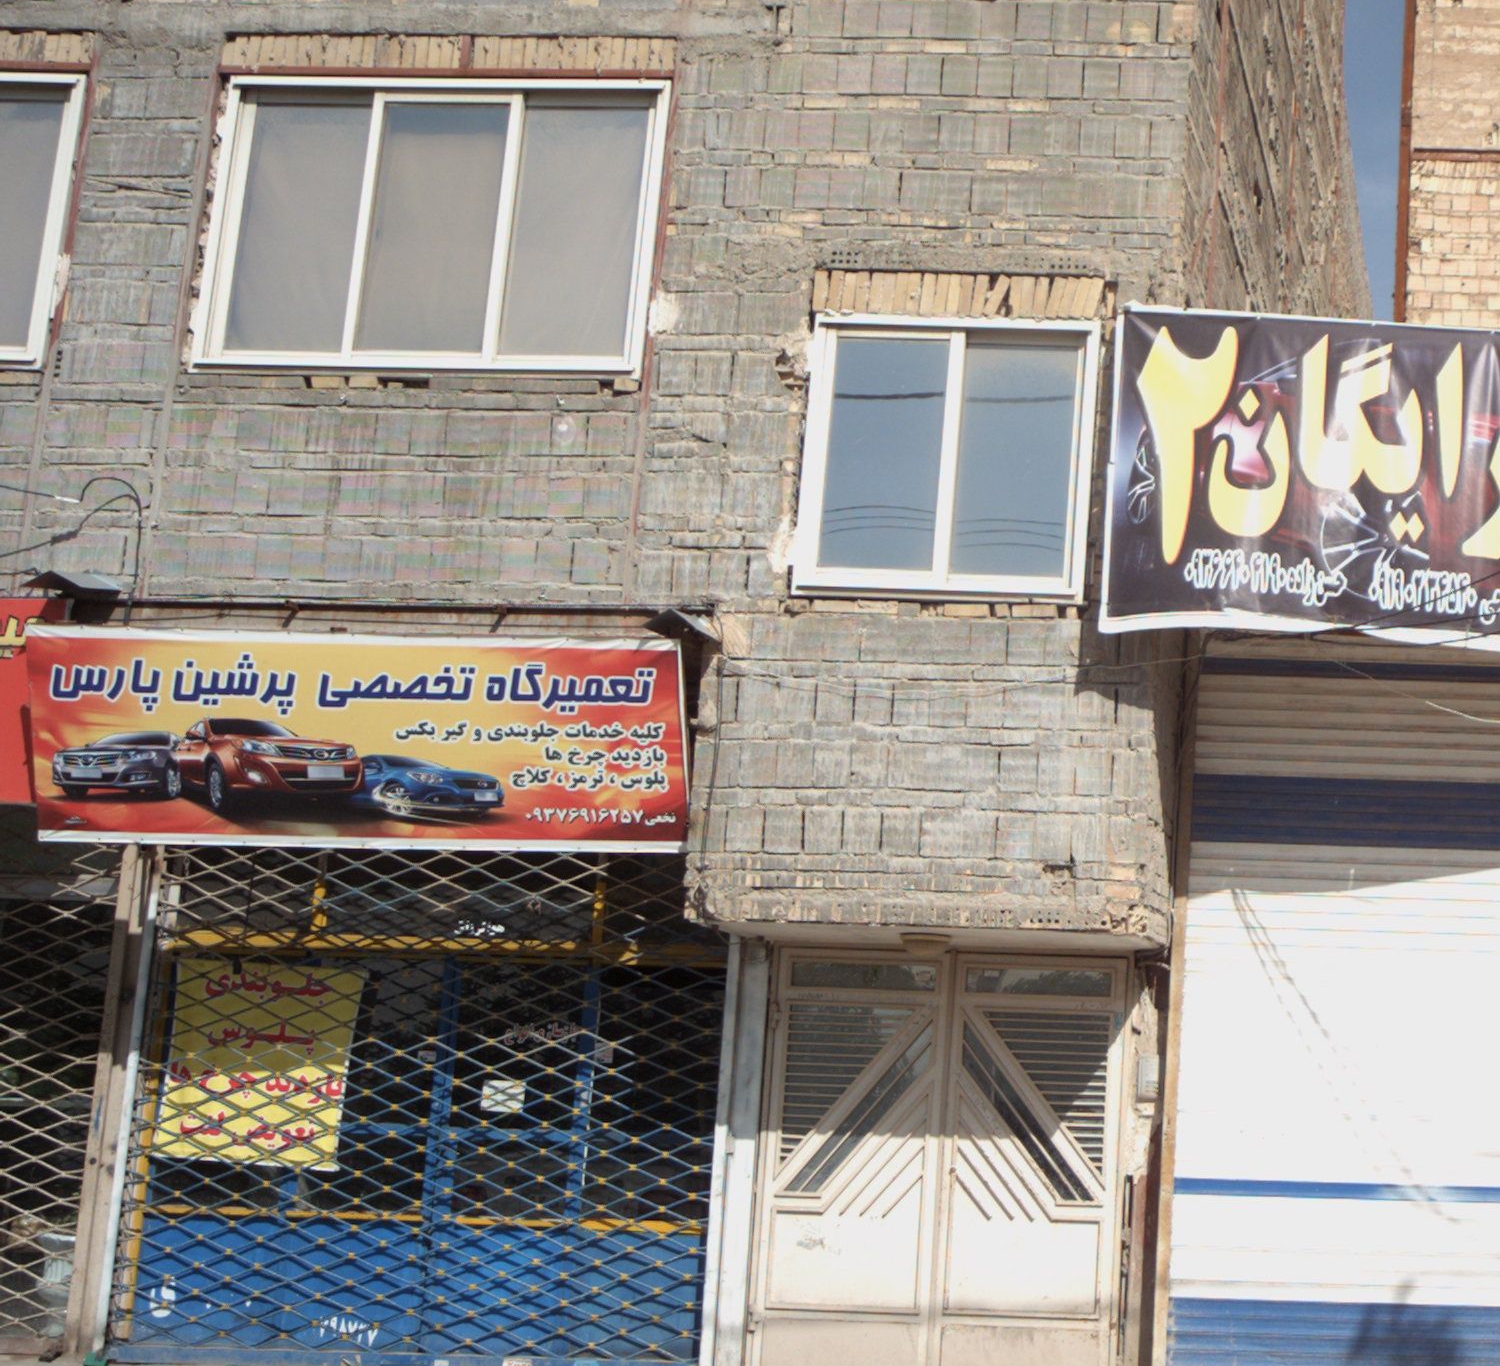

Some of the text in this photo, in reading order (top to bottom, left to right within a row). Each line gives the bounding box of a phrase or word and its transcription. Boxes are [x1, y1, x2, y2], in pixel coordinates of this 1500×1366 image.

[51, 653, 655, 715] تعمیرگاه تخصصی پرشین پارس
[396, 721, 435, 740] بکس
[473, 729, 482, 741] و
[487, 724, 559, 742] جلوبندی
[565, 723, 624, 740] خدمات
[630, 724, 663, 743] کلیه
[545, 746, 665, 768] بازدید چرخ ها
[511, 768, 550, 788] کلاچ
[569, 768, 604, 789] ترمز
[621, 770, 669, 791] پلوس
